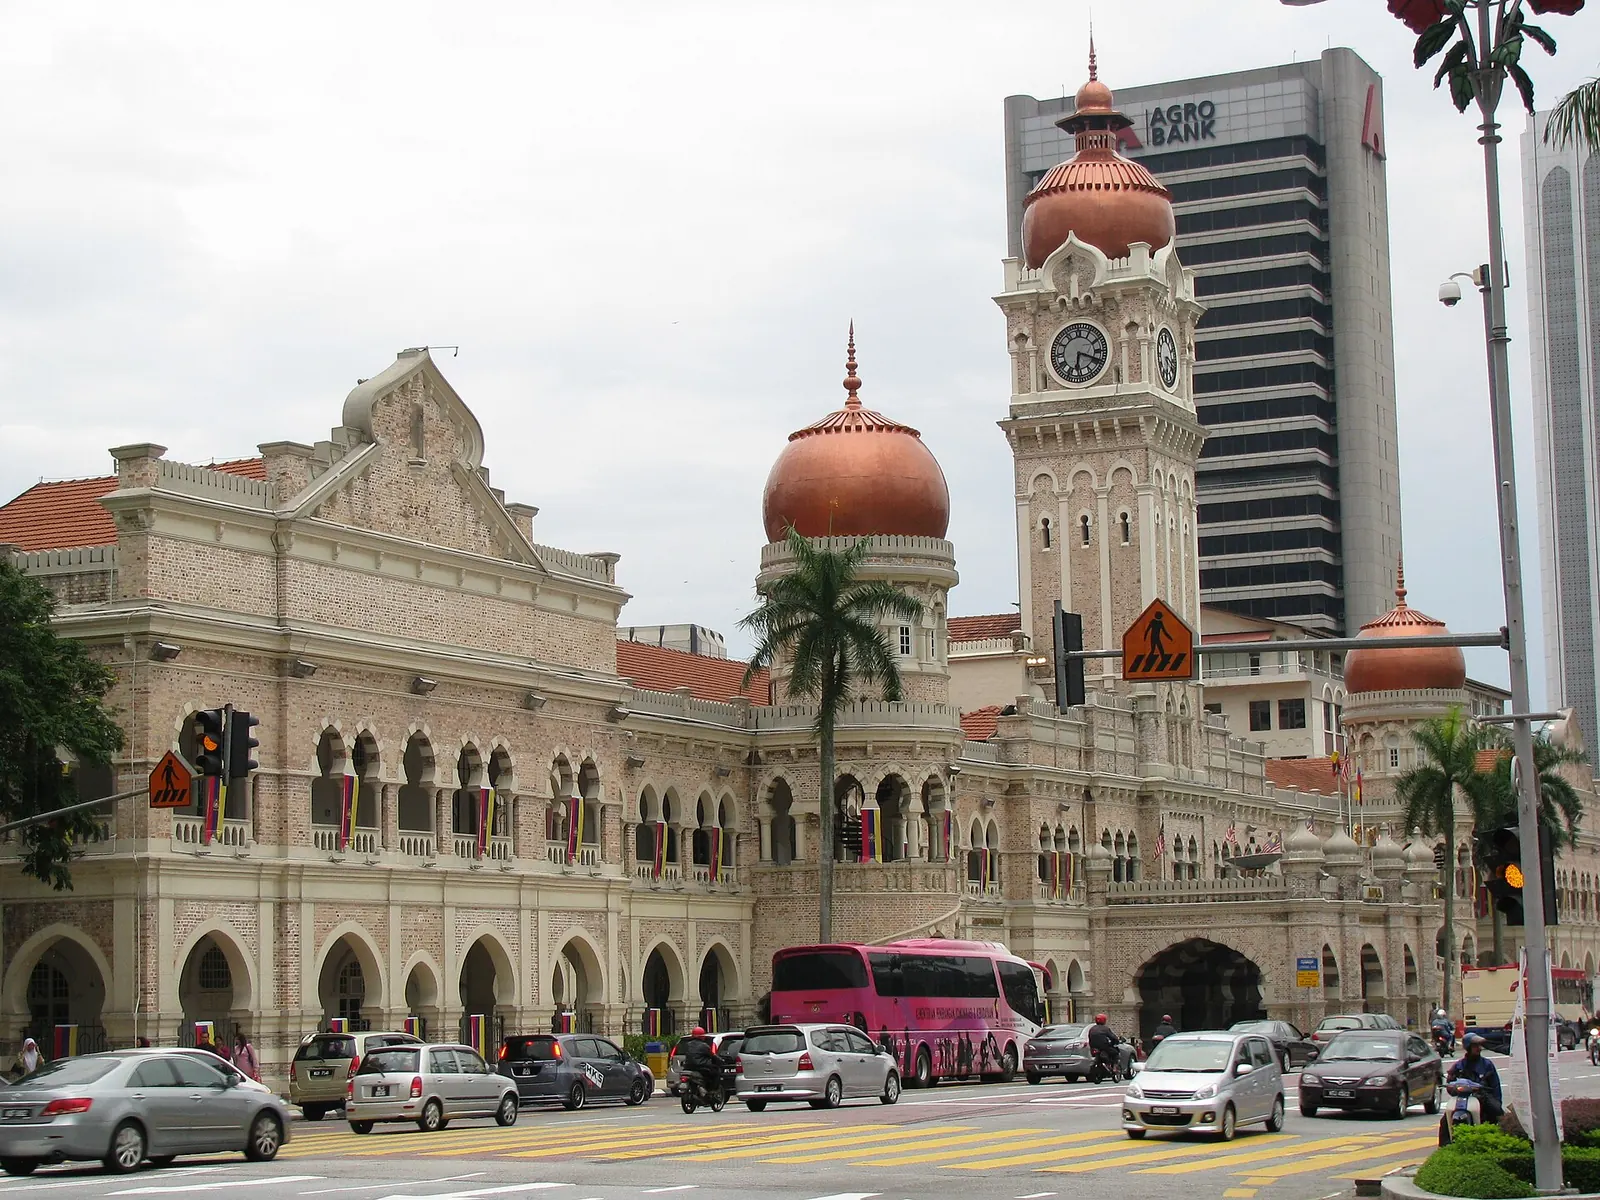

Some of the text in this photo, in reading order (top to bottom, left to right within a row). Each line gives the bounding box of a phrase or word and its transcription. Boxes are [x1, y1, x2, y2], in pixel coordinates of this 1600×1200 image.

[1150, 100, 1215, 126] AGRO
[1152, 119, 1216, 146] BANK
[586, 1065, 603, 1083] HKS
